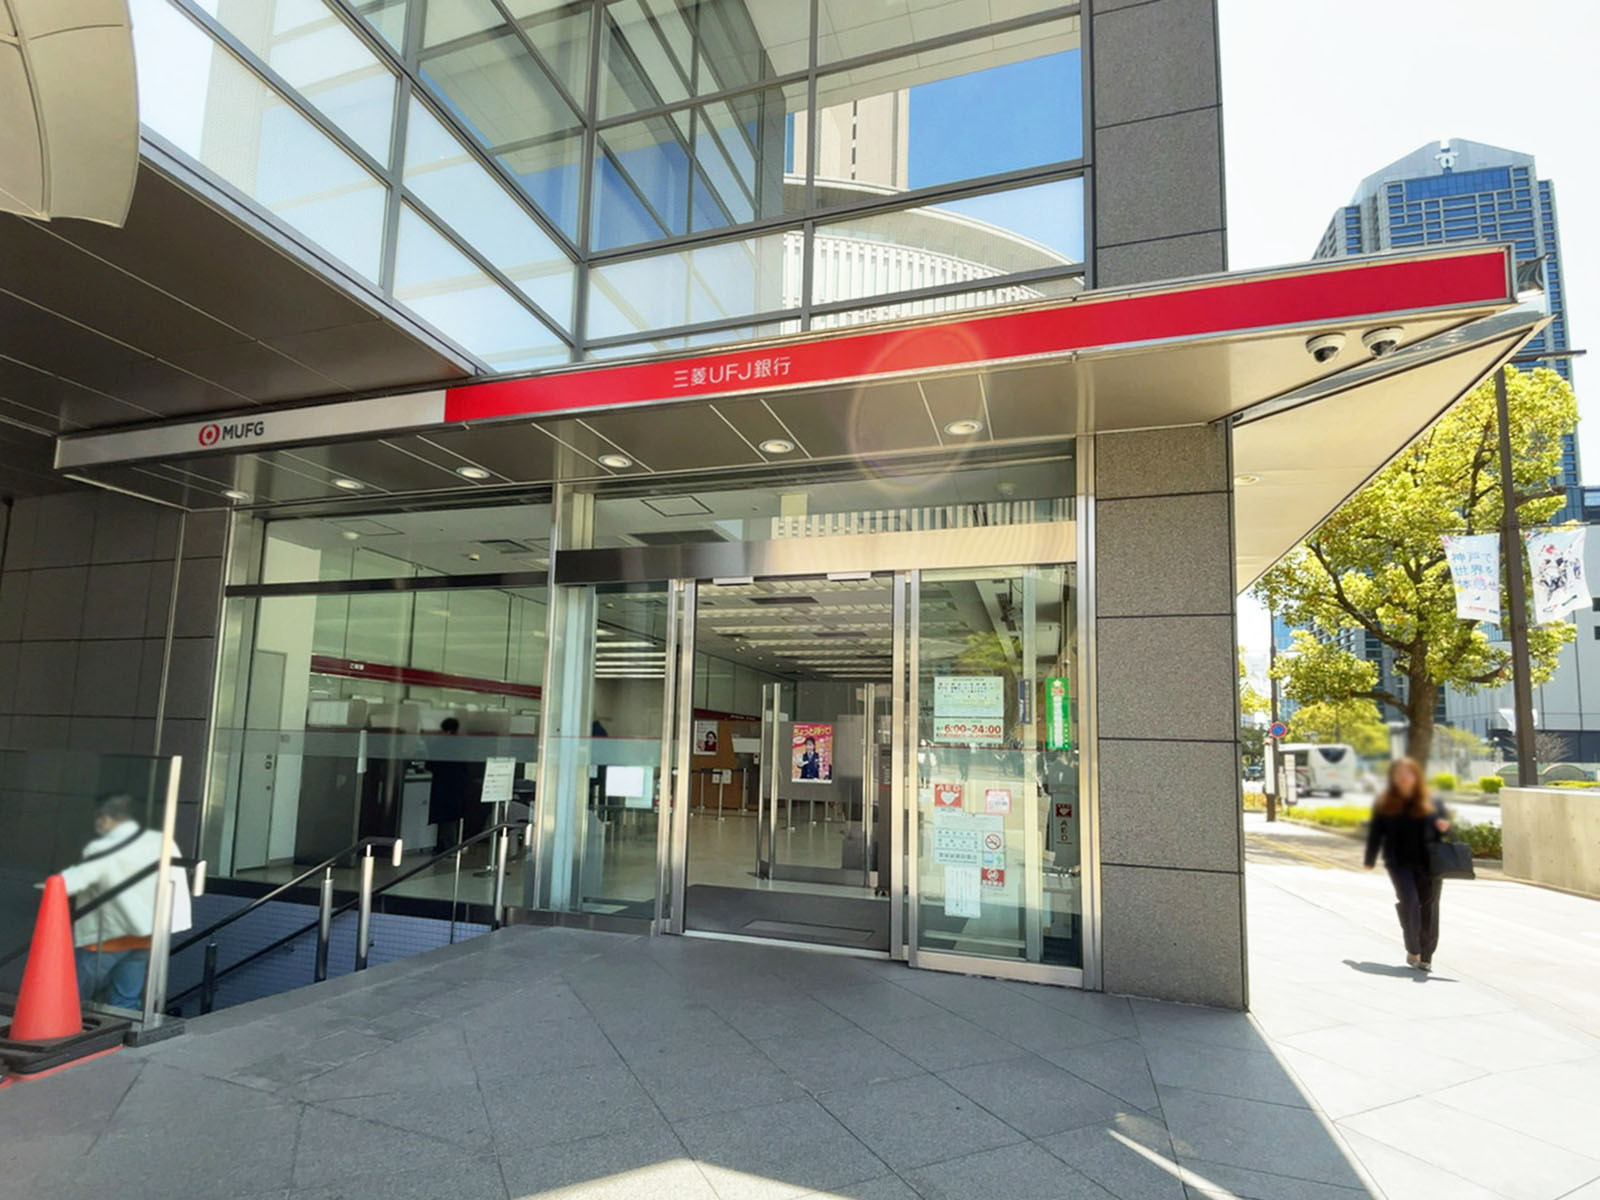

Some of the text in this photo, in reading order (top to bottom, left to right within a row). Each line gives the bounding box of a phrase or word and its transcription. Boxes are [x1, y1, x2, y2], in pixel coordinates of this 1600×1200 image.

[672, 356, 792, 389] 三菱UFJ銀行
[222, 420, 265, 441] MUFG
